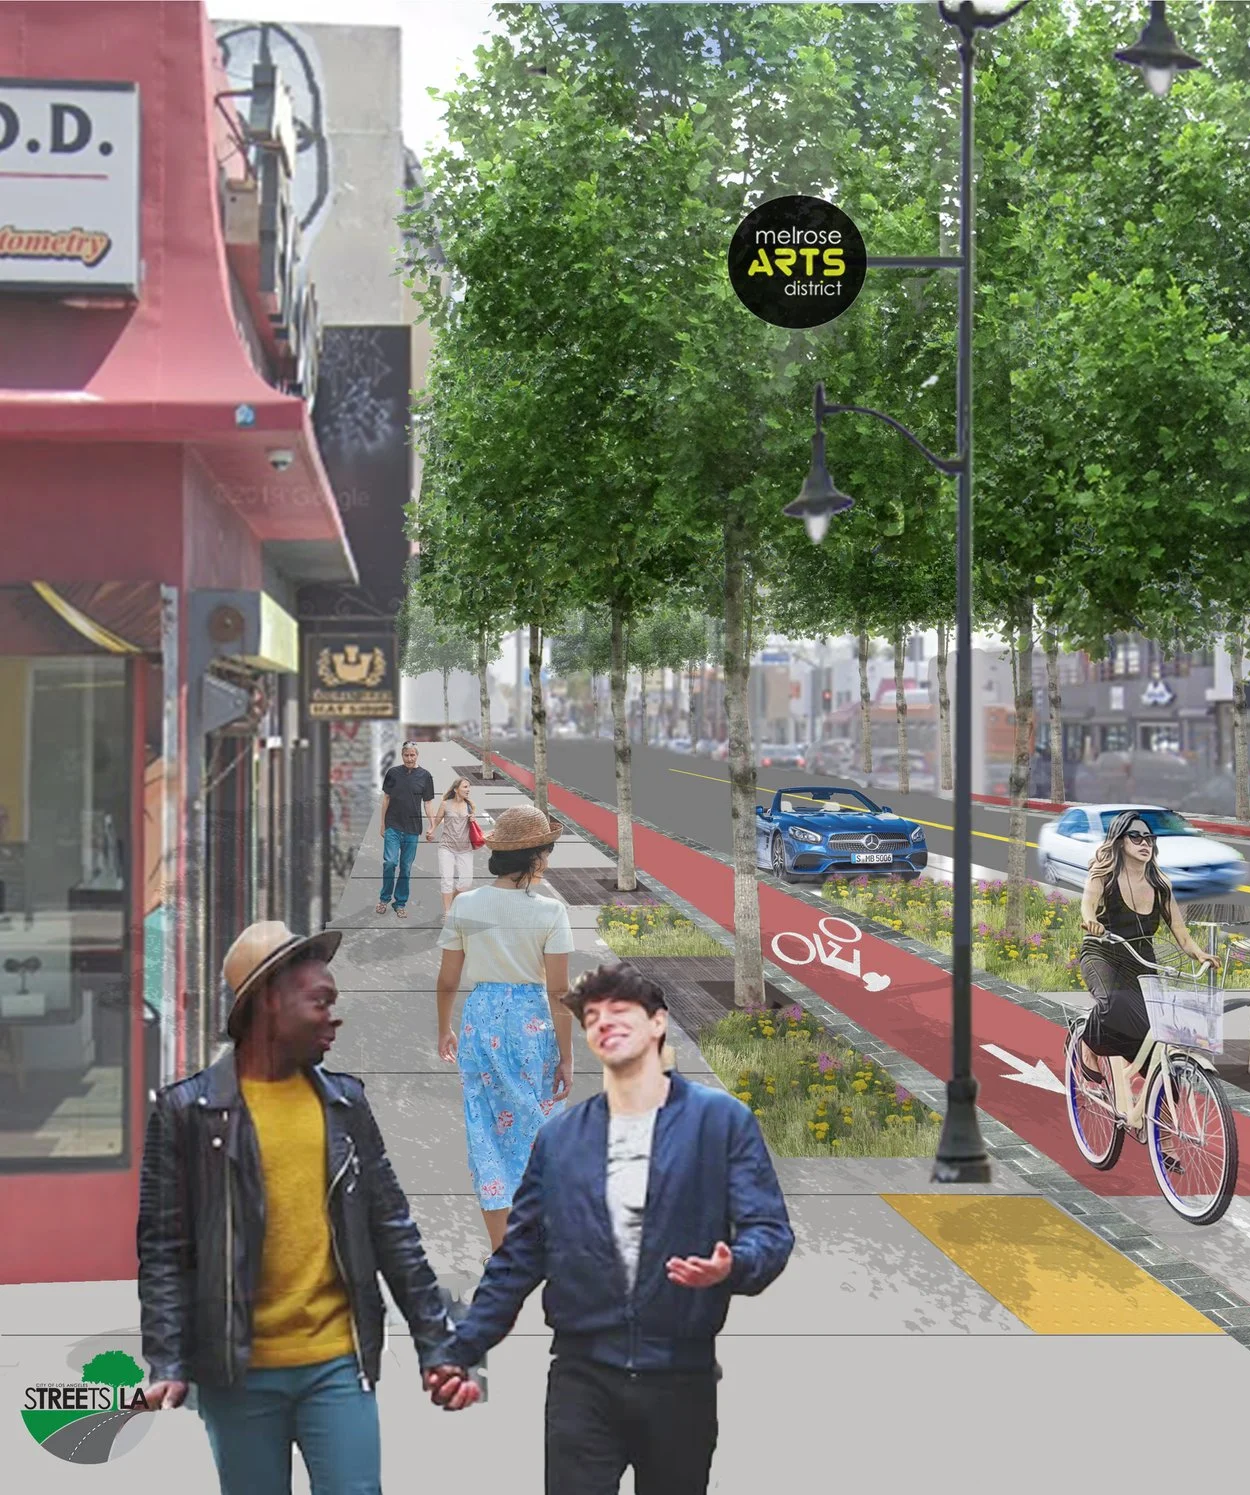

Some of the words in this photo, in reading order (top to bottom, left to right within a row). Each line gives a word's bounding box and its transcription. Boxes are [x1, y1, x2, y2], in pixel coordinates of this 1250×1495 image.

[755, 226, 842, 245] melrose
[748, 248, 846, 277] ARTS
[784, 280, 842, 296] district
